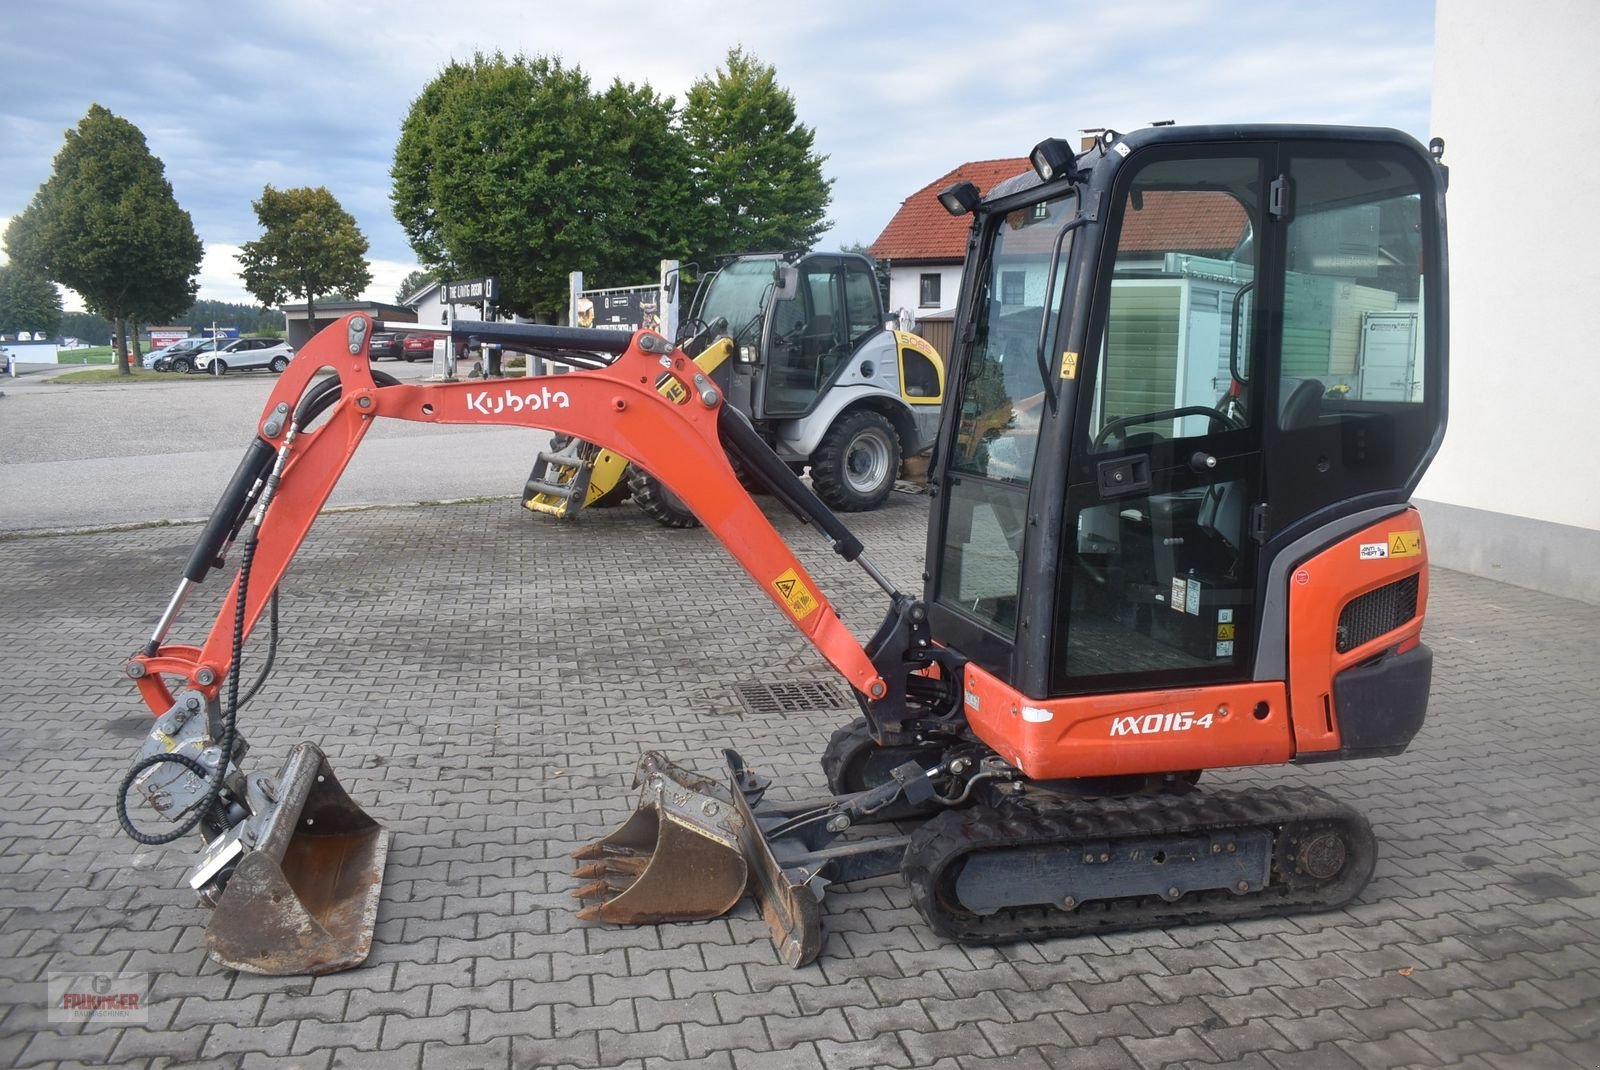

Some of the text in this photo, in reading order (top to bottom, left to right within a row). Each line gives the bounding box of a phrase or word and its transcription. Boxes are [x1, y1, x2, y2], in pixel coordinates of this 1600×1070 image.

[449, 286, 457, 299] THE
[457, 284, 470, 298] LIVING
[471, 283, 483, 297] ROOM
[466, 386, 570, 415] Kubota
[1109, 711, 1213, 737] KX016-4
